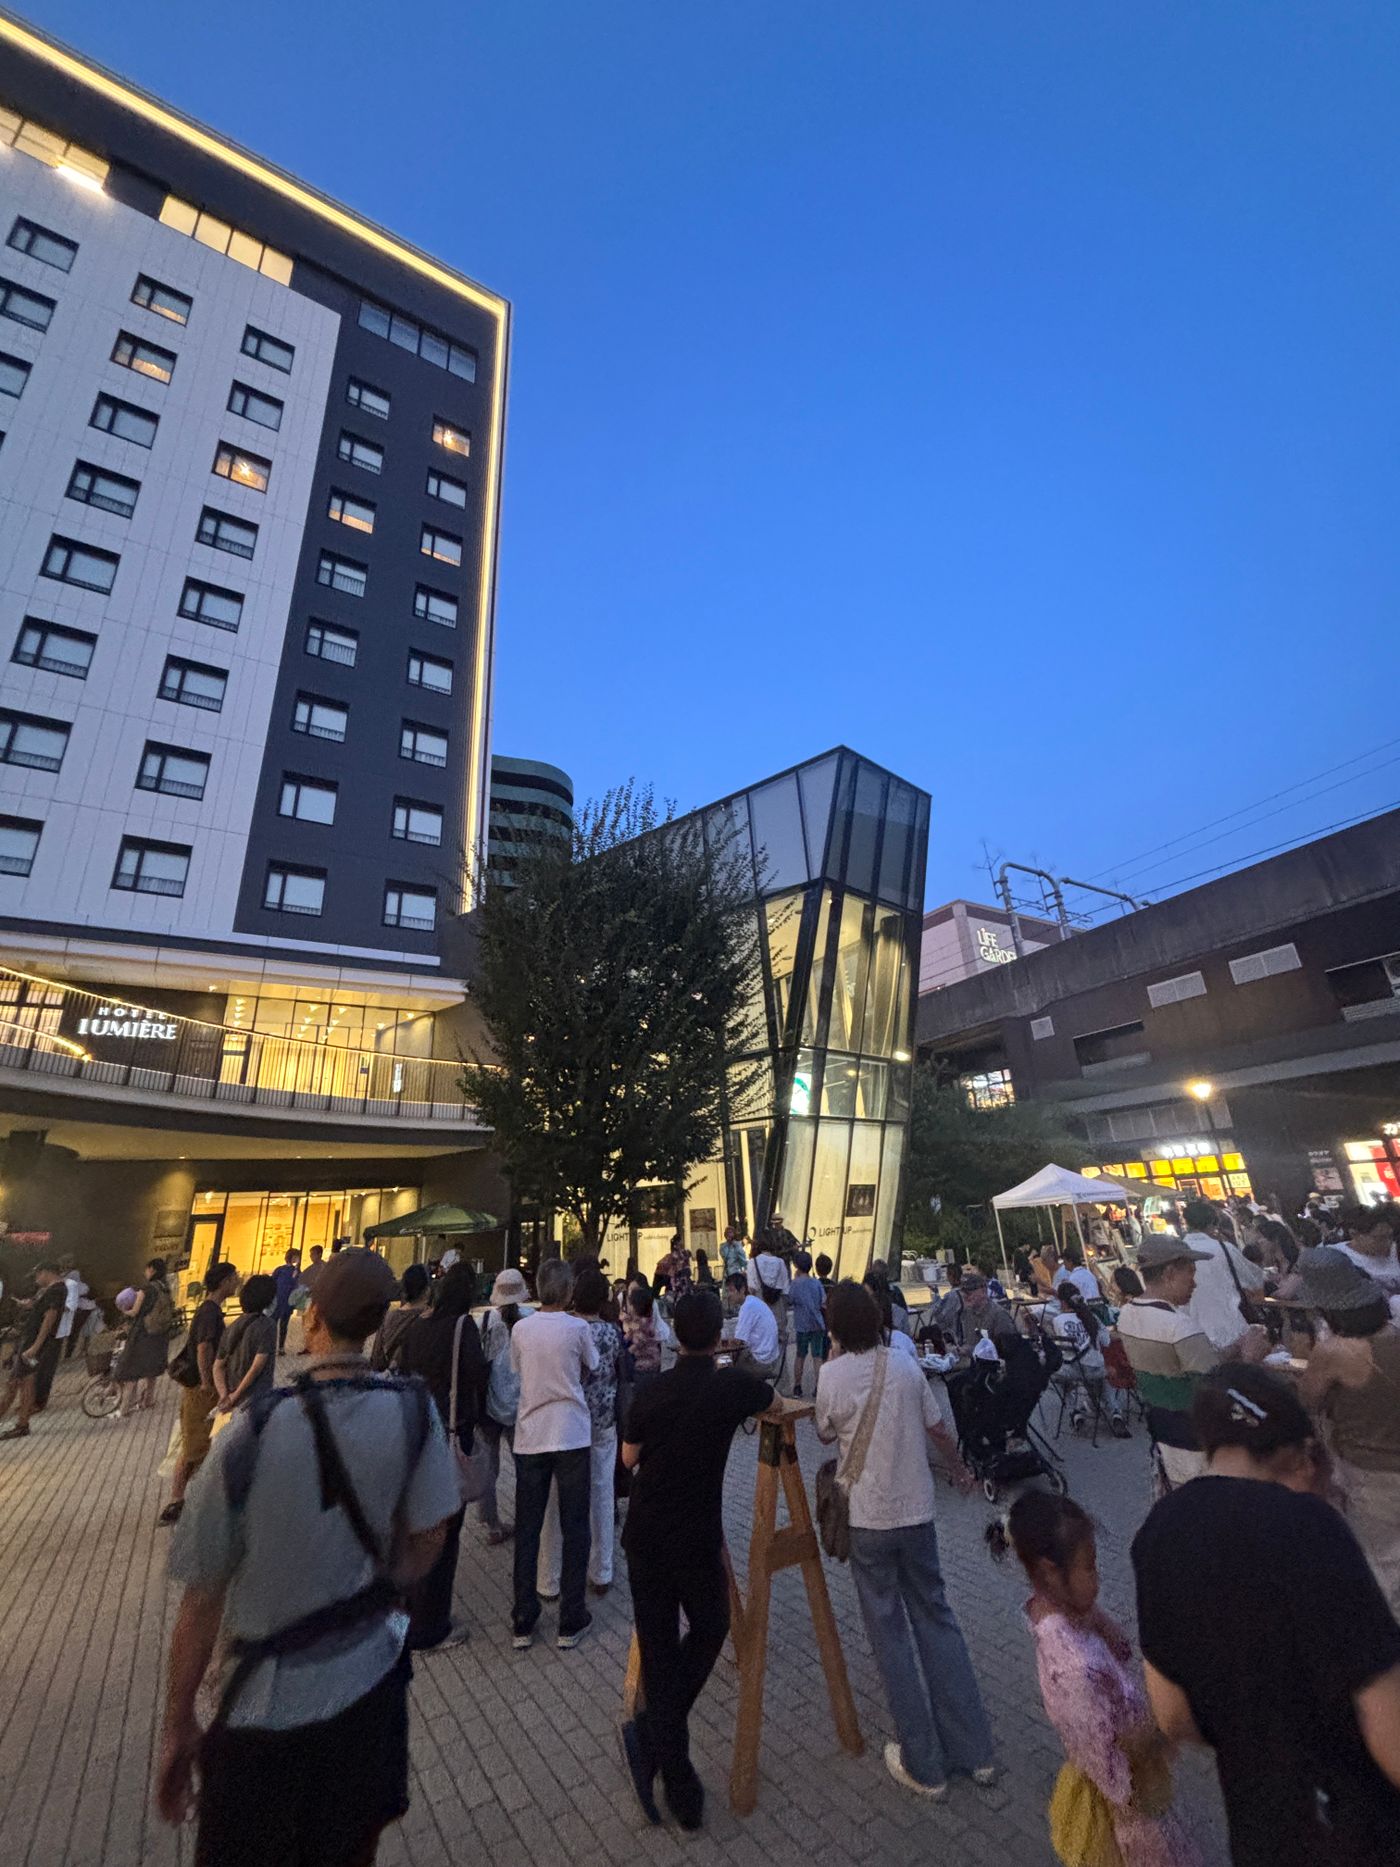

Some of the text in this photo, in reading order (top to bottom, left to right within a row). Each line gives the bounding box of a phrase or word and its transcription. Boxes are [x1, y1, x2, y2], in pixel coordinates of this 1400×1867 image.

[97, 1006, 167, 1019] HOTEL
[606, 1232, 630, 1242] LIGHT
[818, 1226, 841, 1237] LIGHT
